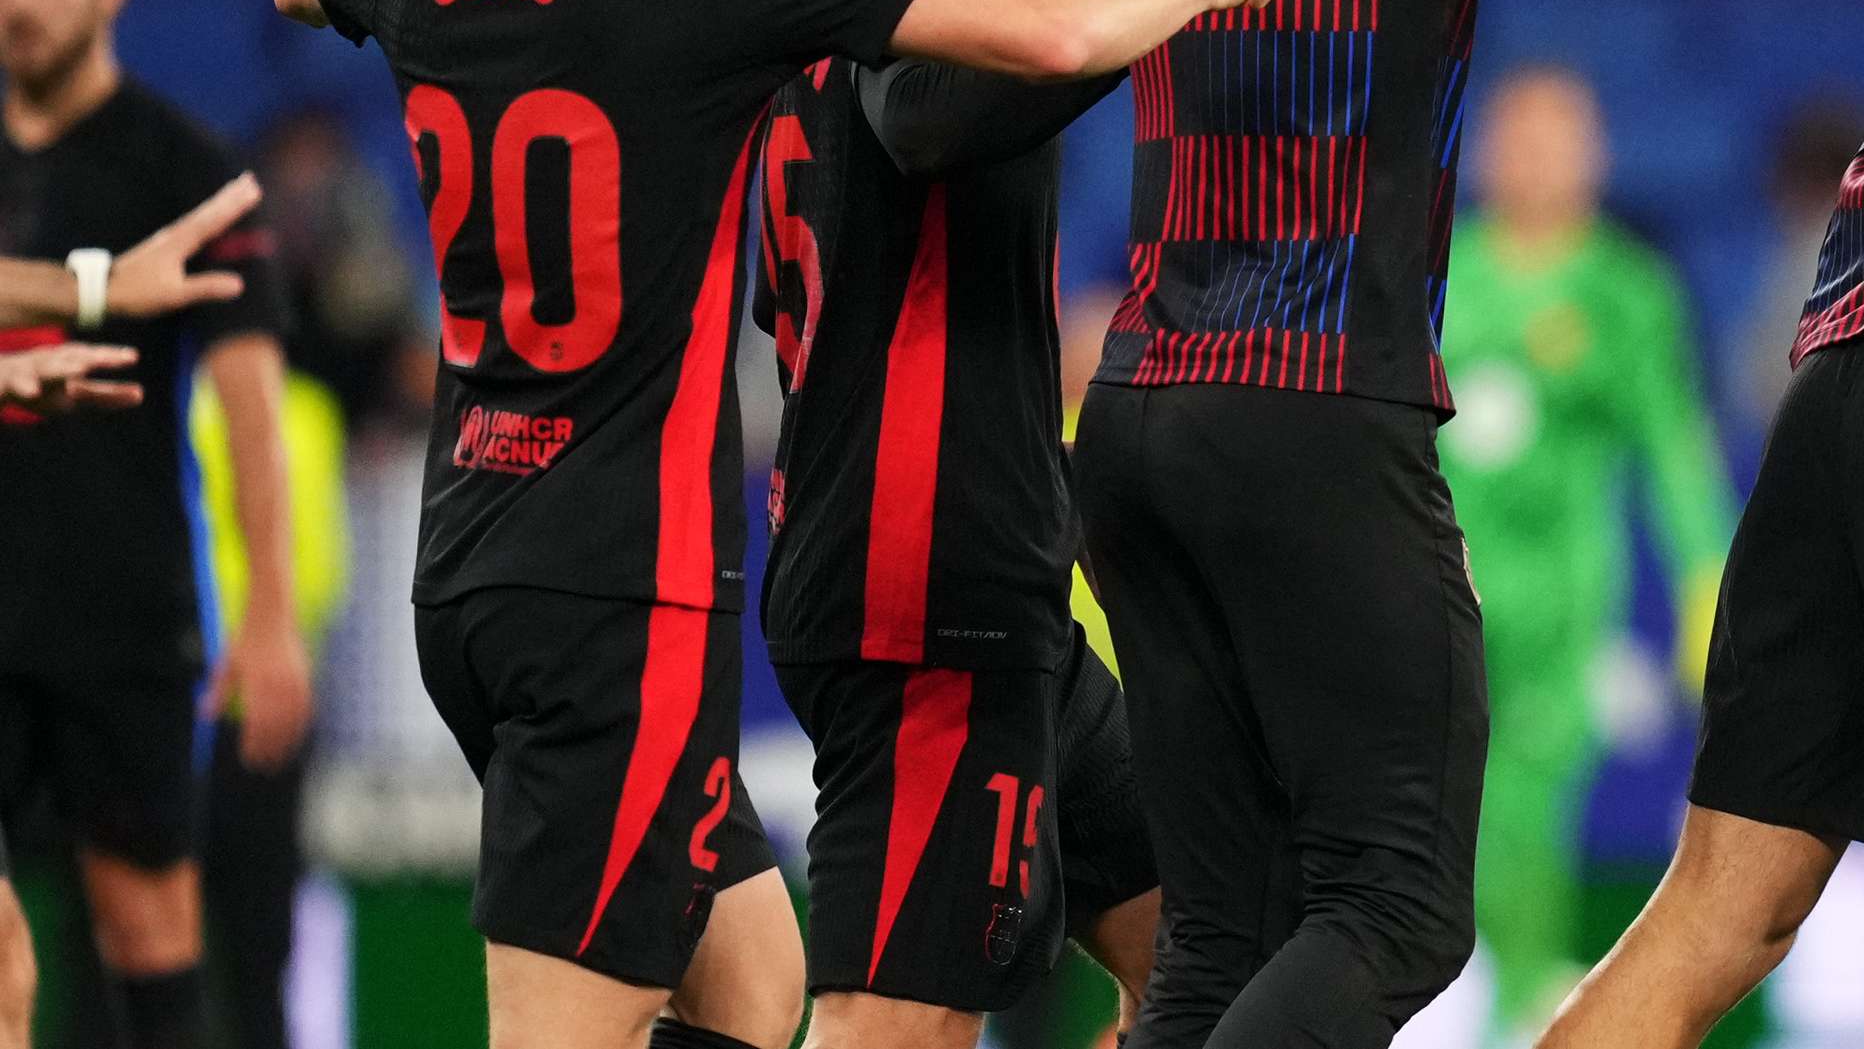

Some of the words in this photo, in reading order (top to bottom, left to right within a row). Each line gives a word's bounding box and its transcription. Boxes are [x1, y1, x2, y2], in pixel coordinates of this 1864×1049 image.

[404, 83, 622, 373] 20
[762, 114, 824, 394] 5
[490, 409, 574, 442] UNHCR
[688, 755, 732, 873] 2
